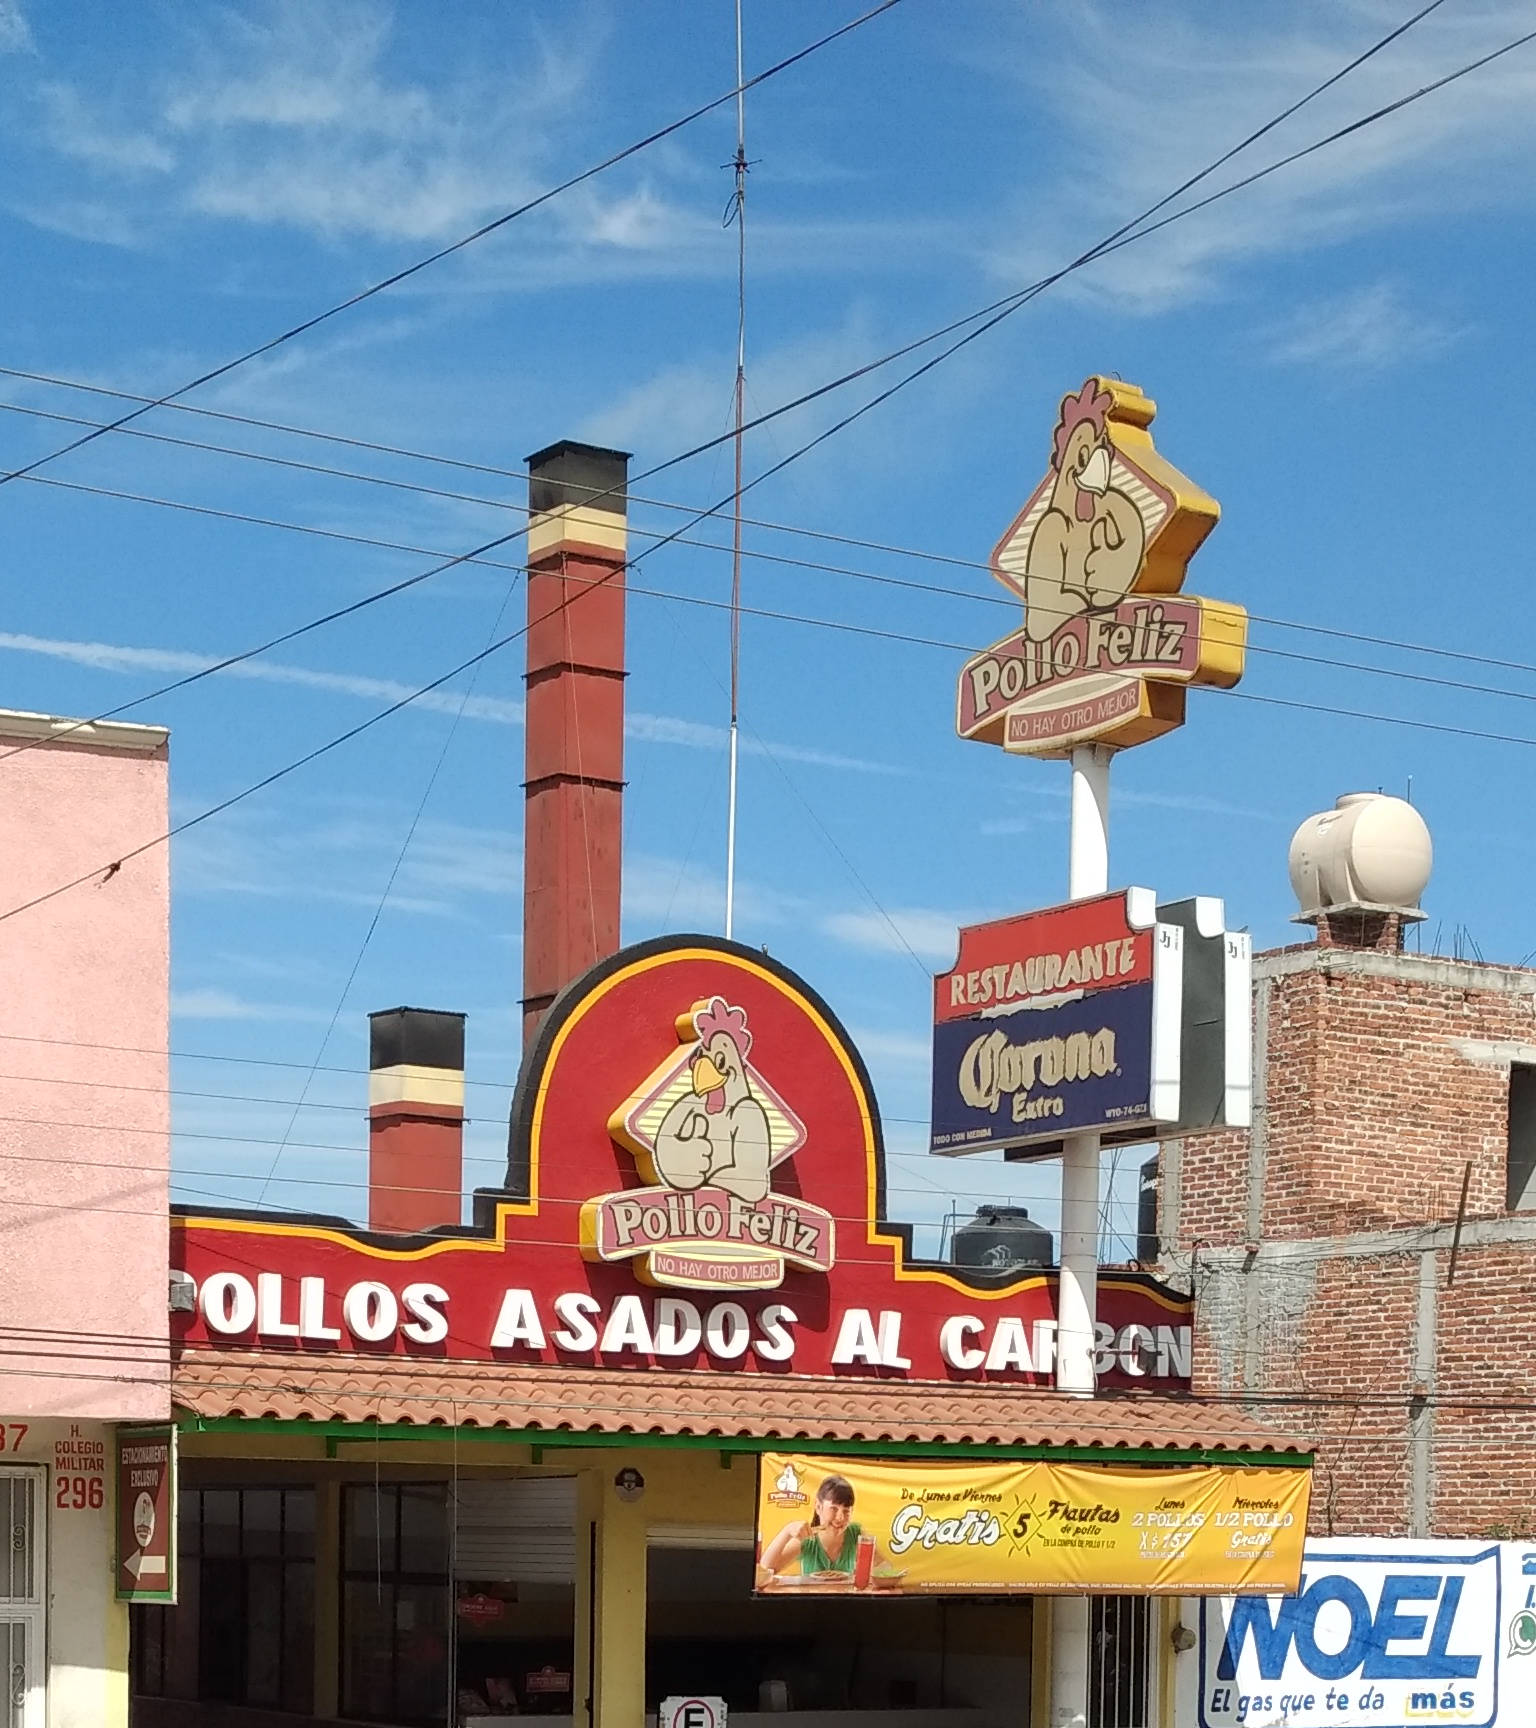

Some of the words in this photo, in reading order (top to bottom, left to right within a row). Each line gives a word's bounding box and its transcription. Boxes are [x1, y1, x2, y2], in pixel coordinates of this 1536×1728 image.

[970, 632, 1081, 718] Pollo
[1085, 604, 1187, 669] Feliz
[1012, 718, 1028, 737] NO
[1033, 715, 1055, 734] HAY
[1061, 708, 1093, 730] OTRO
[1097, 686, 1136, 718] MEJOR
[950, 936, 1136, 1007] RESTAURANTE
[958, 1026, 1119, 1114] Corona
[609, 1193, 723, 1247] Pollo
[726, 1194, 820, 1258] Feliz
[657, 1257, 675, 1273] NO
[679, 1263, 703, 1278] HAY
[708, 1265, 738, 1280] OTRO
[742, 1263, 778, 1279] MEJOR
[490, 1288, 799, 1362] ASADOS
[830, 1308, 913, 1370] AL
[54, 1440, 104, 1455] COLEGIO
[55, 1456, 105, 1472] MILITAR
[130, 1469, 159, 1488] EXCLUSIVO
[56, 1475, 105, 1509] 296
[900, 1488, 915, 1500] De
[918, 1488, 951, 1504] Lunes
[962, 1488, 1003, 1504] Viernes
[1155, 1497, 1186, 1511] Lunes
[1047, 1499, 1121, 1524] Flautas
[1131, 1512, 1144, 1527] 2
[1214, 1512, 1240, 1527] 1/2
[1242, 1512, 1294, 1528] POLLO
[888, 1503, 1001, 1555] Gratis
[1012, 1512, 1032, 1539] 5
[1072, 1524, 1103, 1537] pollo
[1216, 1573, 1483, 1681] NOEL
[1211, 1688, 1231, 1713] El
[1236, 1693, 1273, 1722] gas
[1279, 1692, 1316, 1719] que
[1325, 1687, 1350, 1711] te
[1358, 1685, 1385, 1711] da
[1411, 1682, 1476, 1710] más
